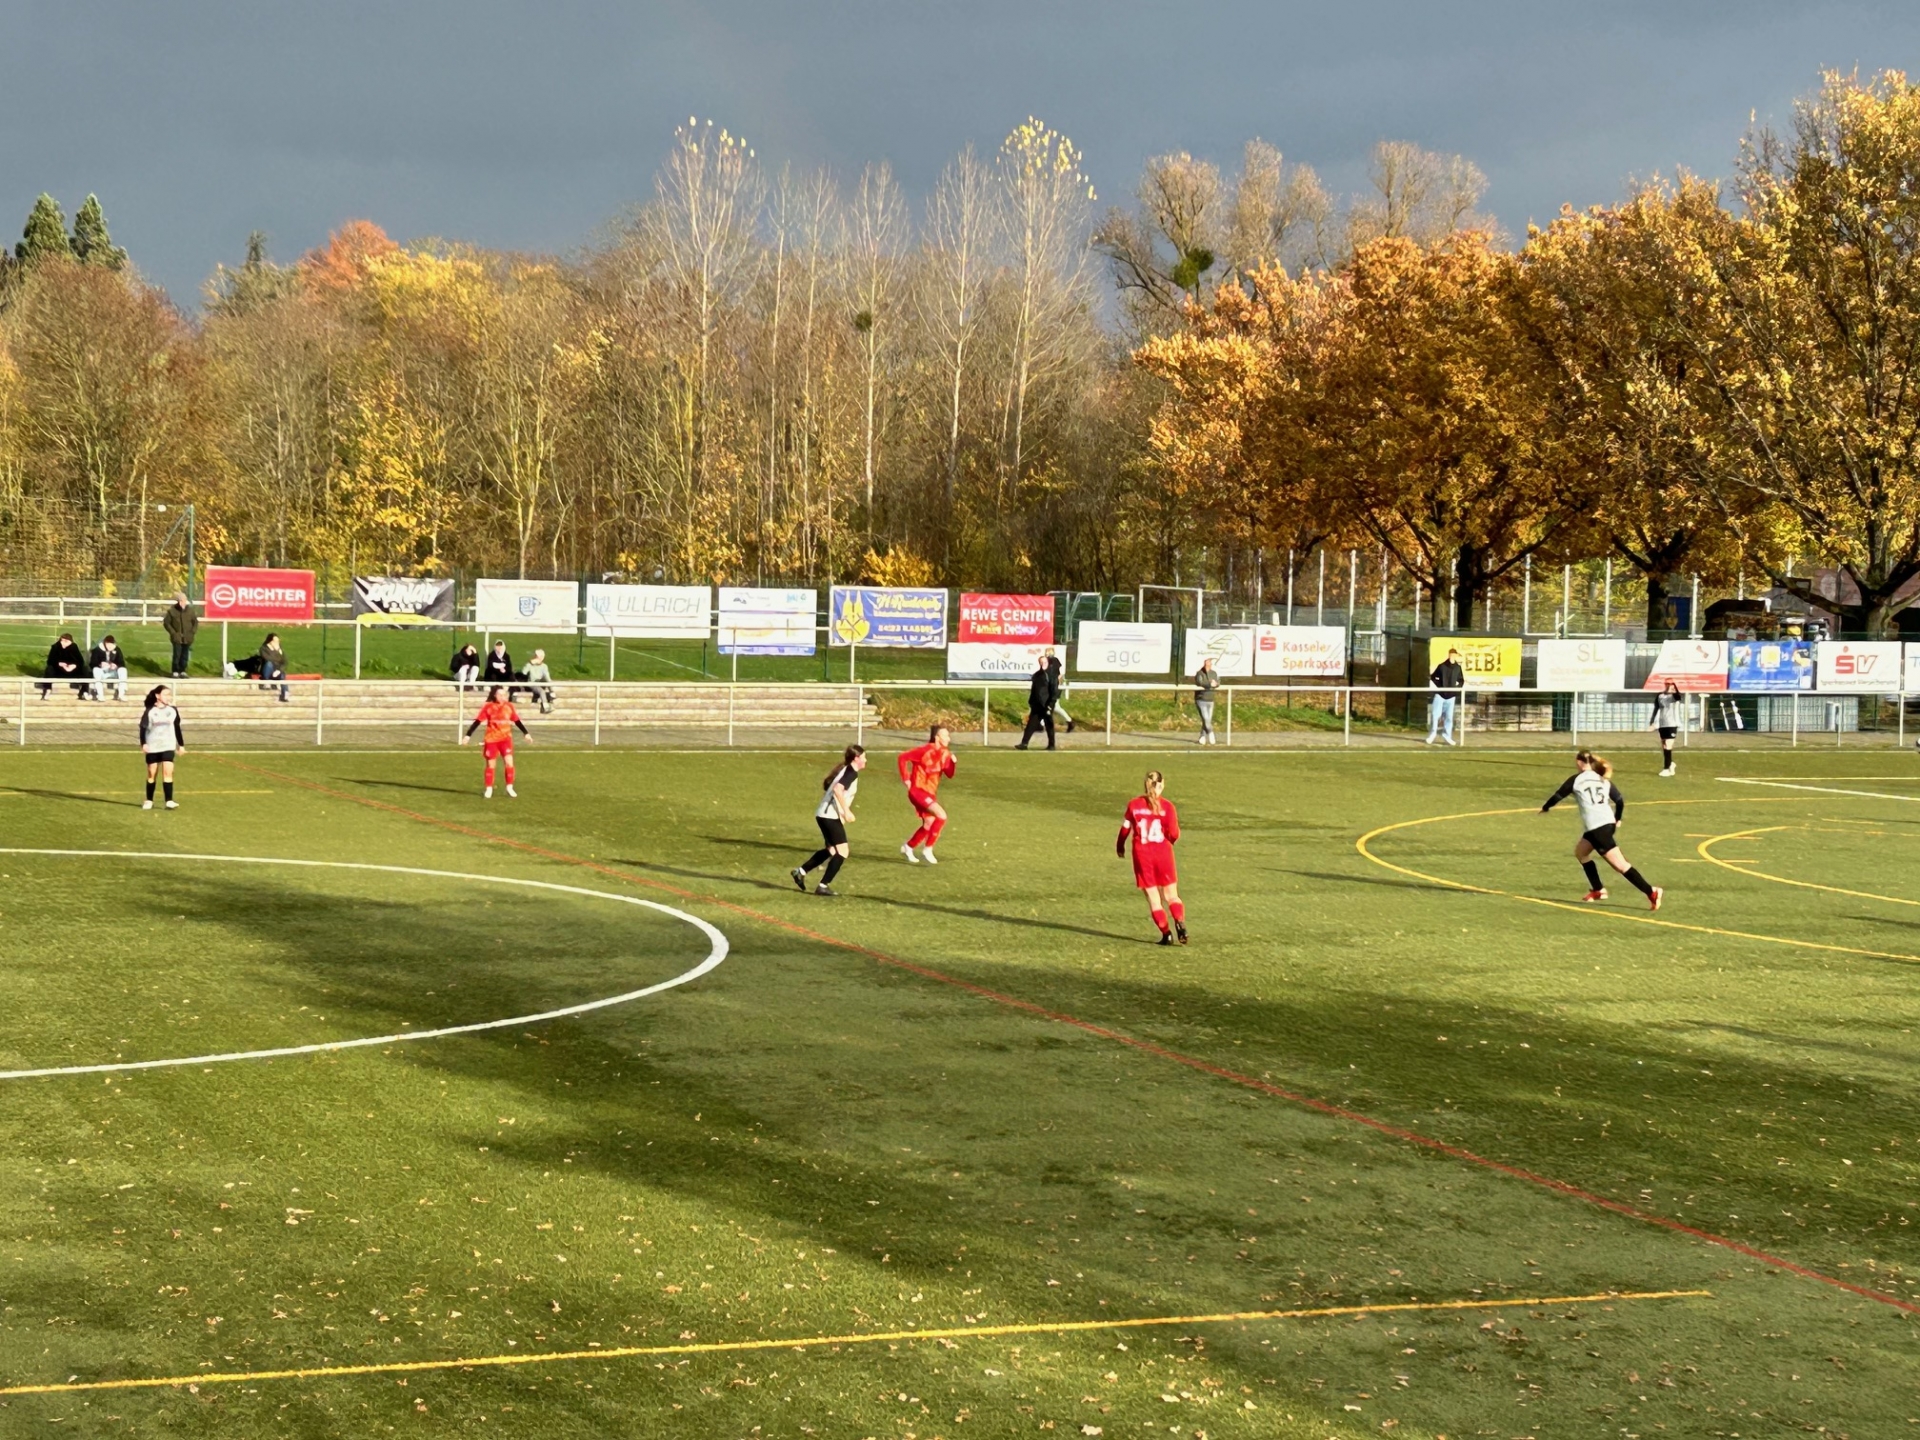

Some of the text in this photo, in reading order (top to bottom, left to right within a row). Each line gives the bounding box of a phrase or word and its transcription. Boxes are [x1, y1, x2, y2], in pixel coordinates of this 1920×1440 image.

[238, 587, 306, 601] RICHTER
[617, 596, 700, 613] ULLRICH
[962, 608, 1050, 622] REWE CENTER
[1282, 640, 1331, 653] Kasseler
[1577, 643, 1603, 662] SL
[1107, 650, 1141, 667] agc
[1282, 657, 1341, 670] Sparkasse
[1584, 786, 1605, 805] 15
[1137, 818, 1164, 844] 14
